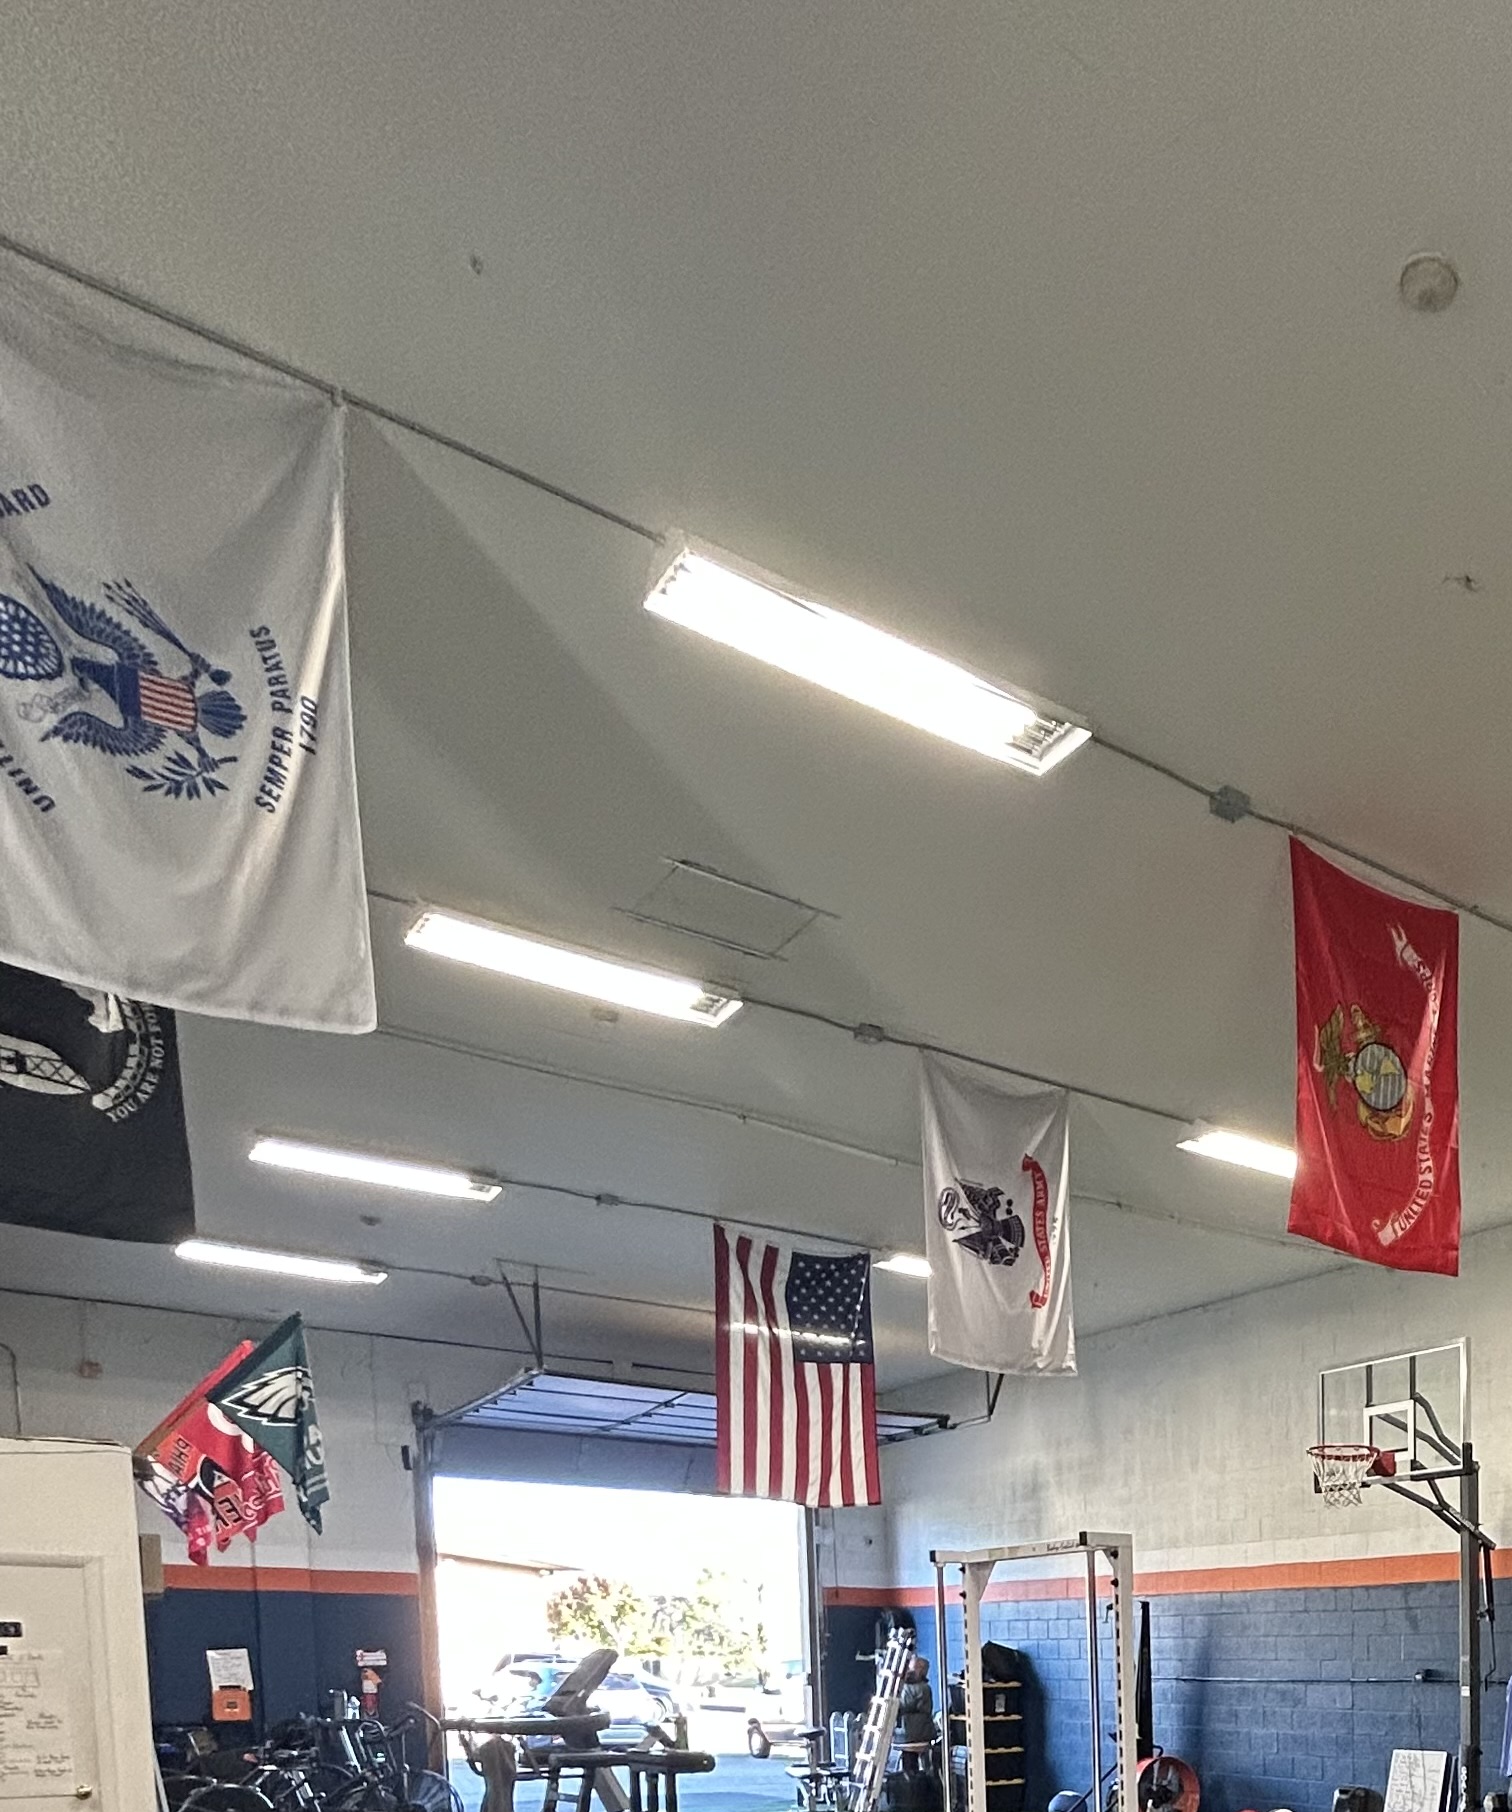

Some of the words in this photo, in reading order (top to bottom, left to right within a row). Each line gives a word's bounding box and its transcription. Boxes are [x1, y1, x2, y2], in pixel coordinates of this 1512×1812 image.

[0, 484, 50, 518] ARD
[250, 625, 293, 714] PARATUS
[298, 696, 317, 755] 1790
[0, 740, 55, 812] UNIT
[255, 726, 293, 814] SEMPER
[106, 1097, 138, 1122] YOU
[136, 1073, 160, 1103] ARE
[150, 1036, 165, 1069] NOT
[1034, 1172, 1047, 1207] ARMY
[1397, 1179, 1432, 1233] UNITED
[1035, 1210, 1048, 1252] STATES
